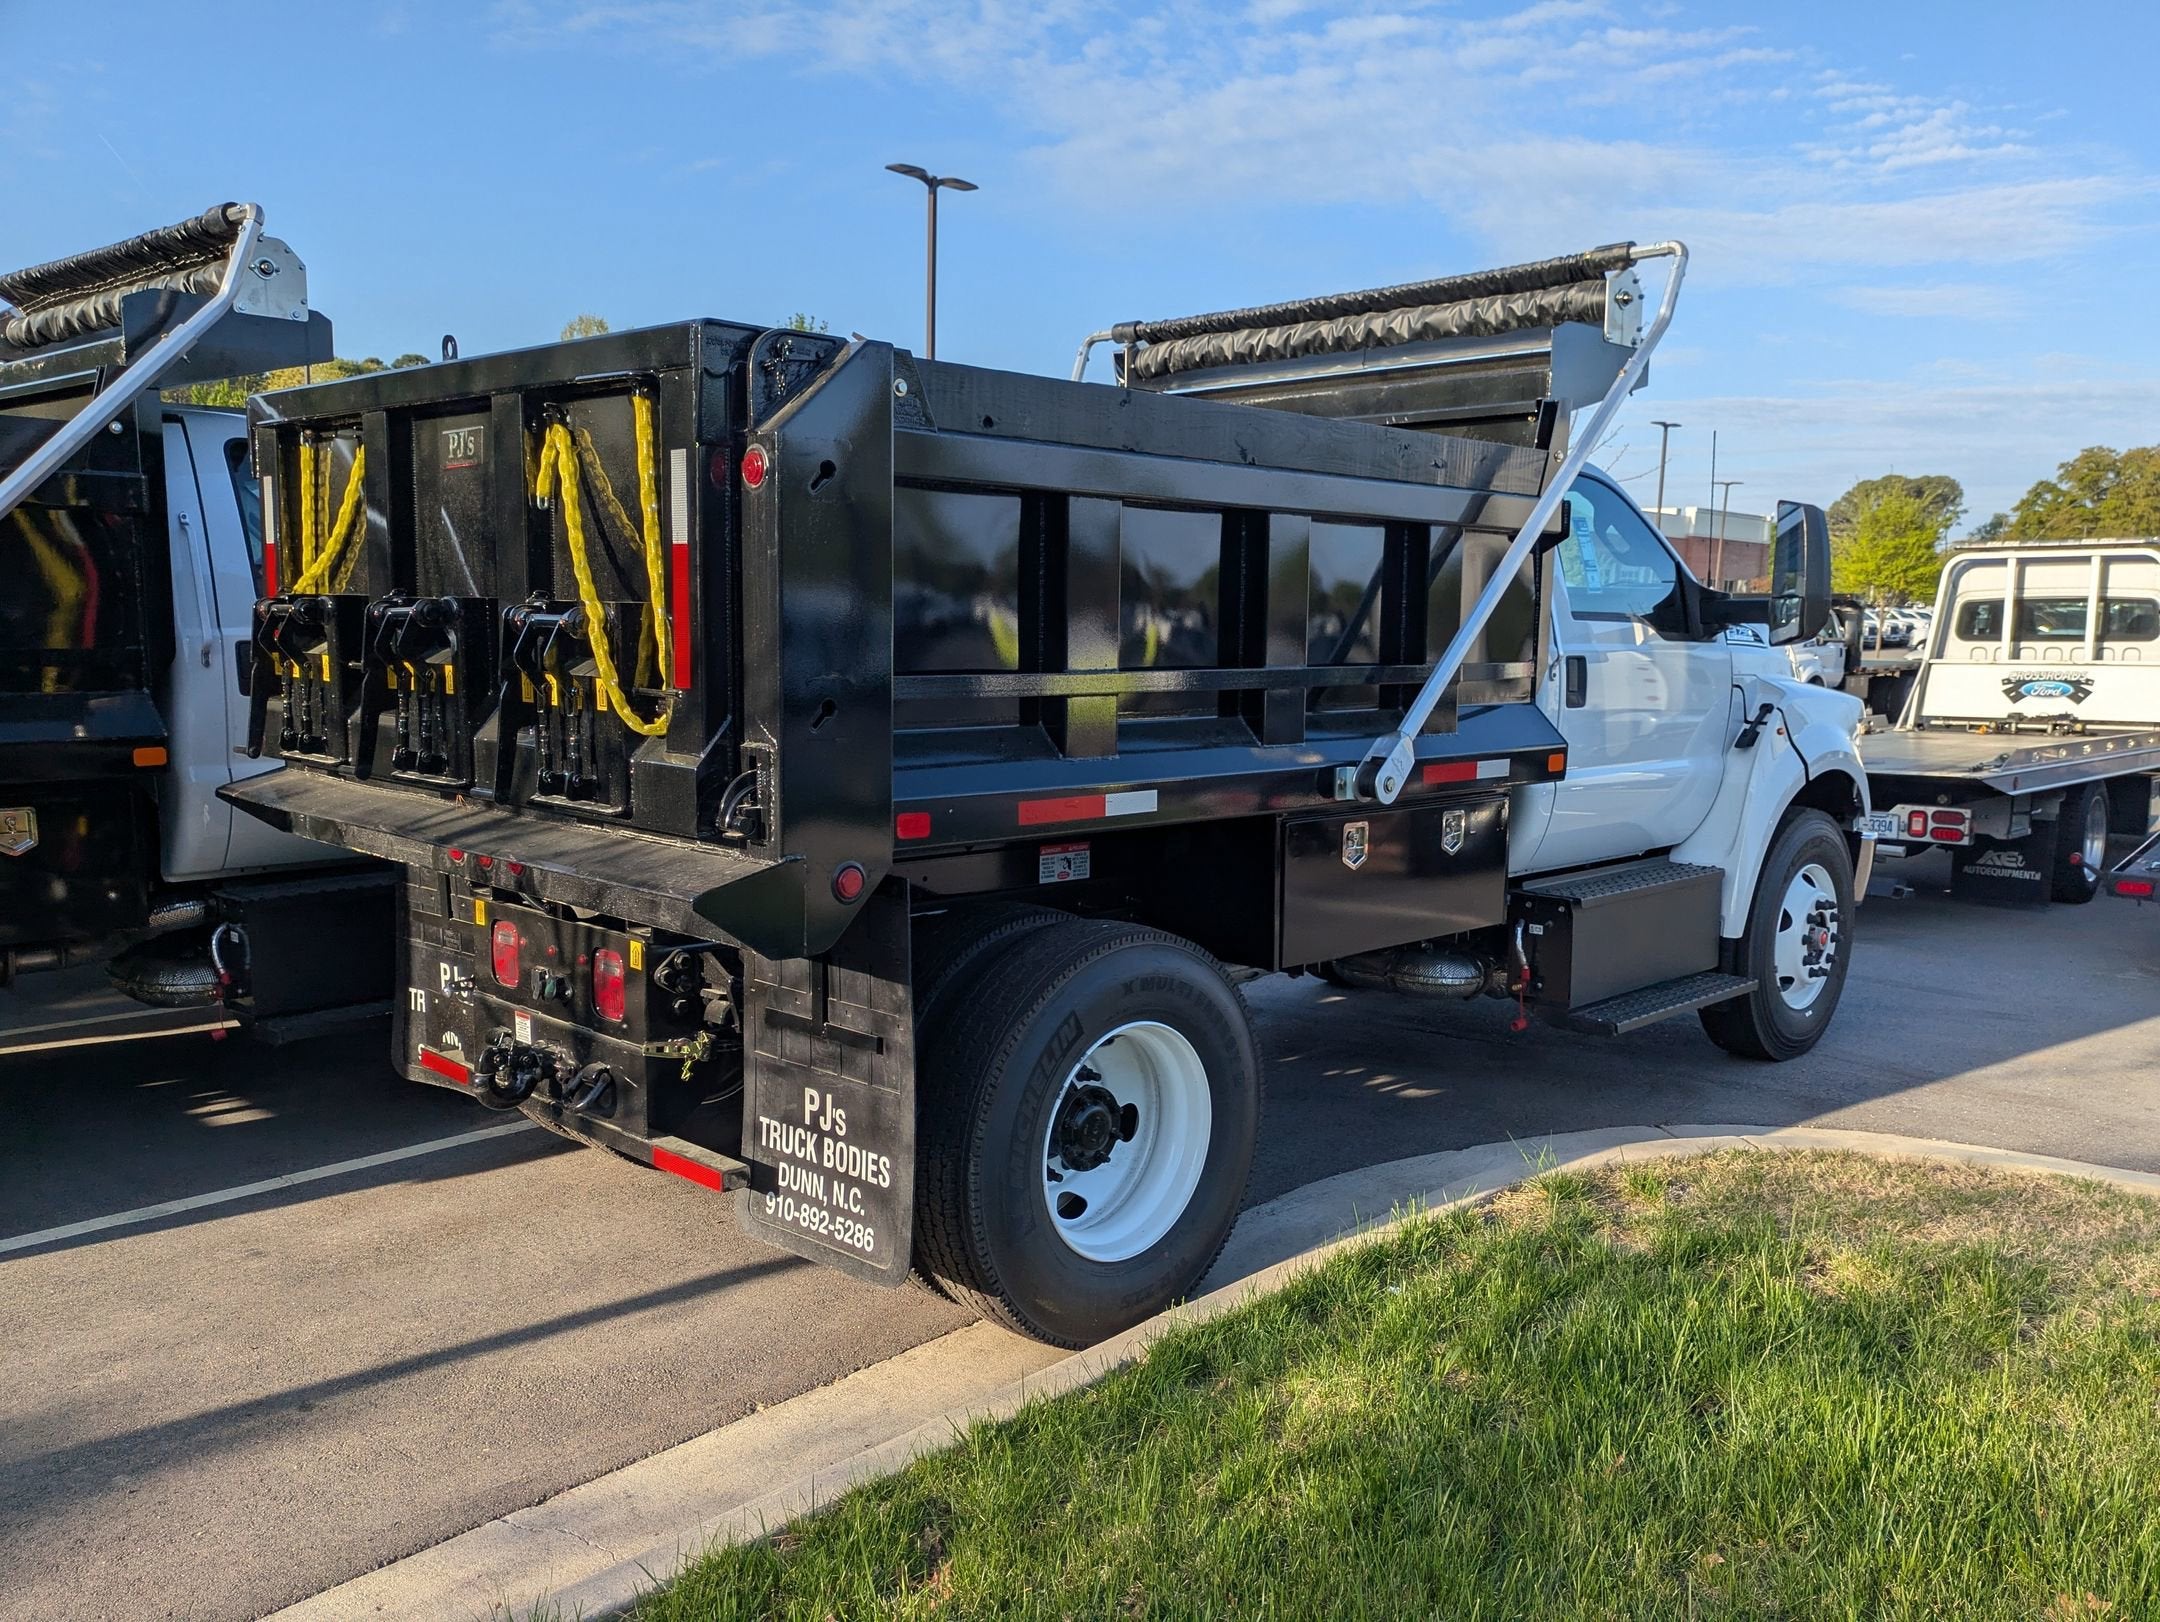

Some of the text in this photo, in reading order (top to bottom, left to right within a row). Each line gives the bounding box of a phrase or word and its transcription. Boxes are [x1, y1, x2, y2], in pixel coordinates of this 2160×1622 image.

[449, 430, 475, 458] PJ's
[2030, 682, 2065, 696] Ford
[804, 1087, 847, 1137] PJ's
[759, 1115, 891, 1189] TRUCK BODIES
[778, 1161, 865, 1216] DUNN, N.C.
[765, 1191, 875, 1252] 910-892-5286
